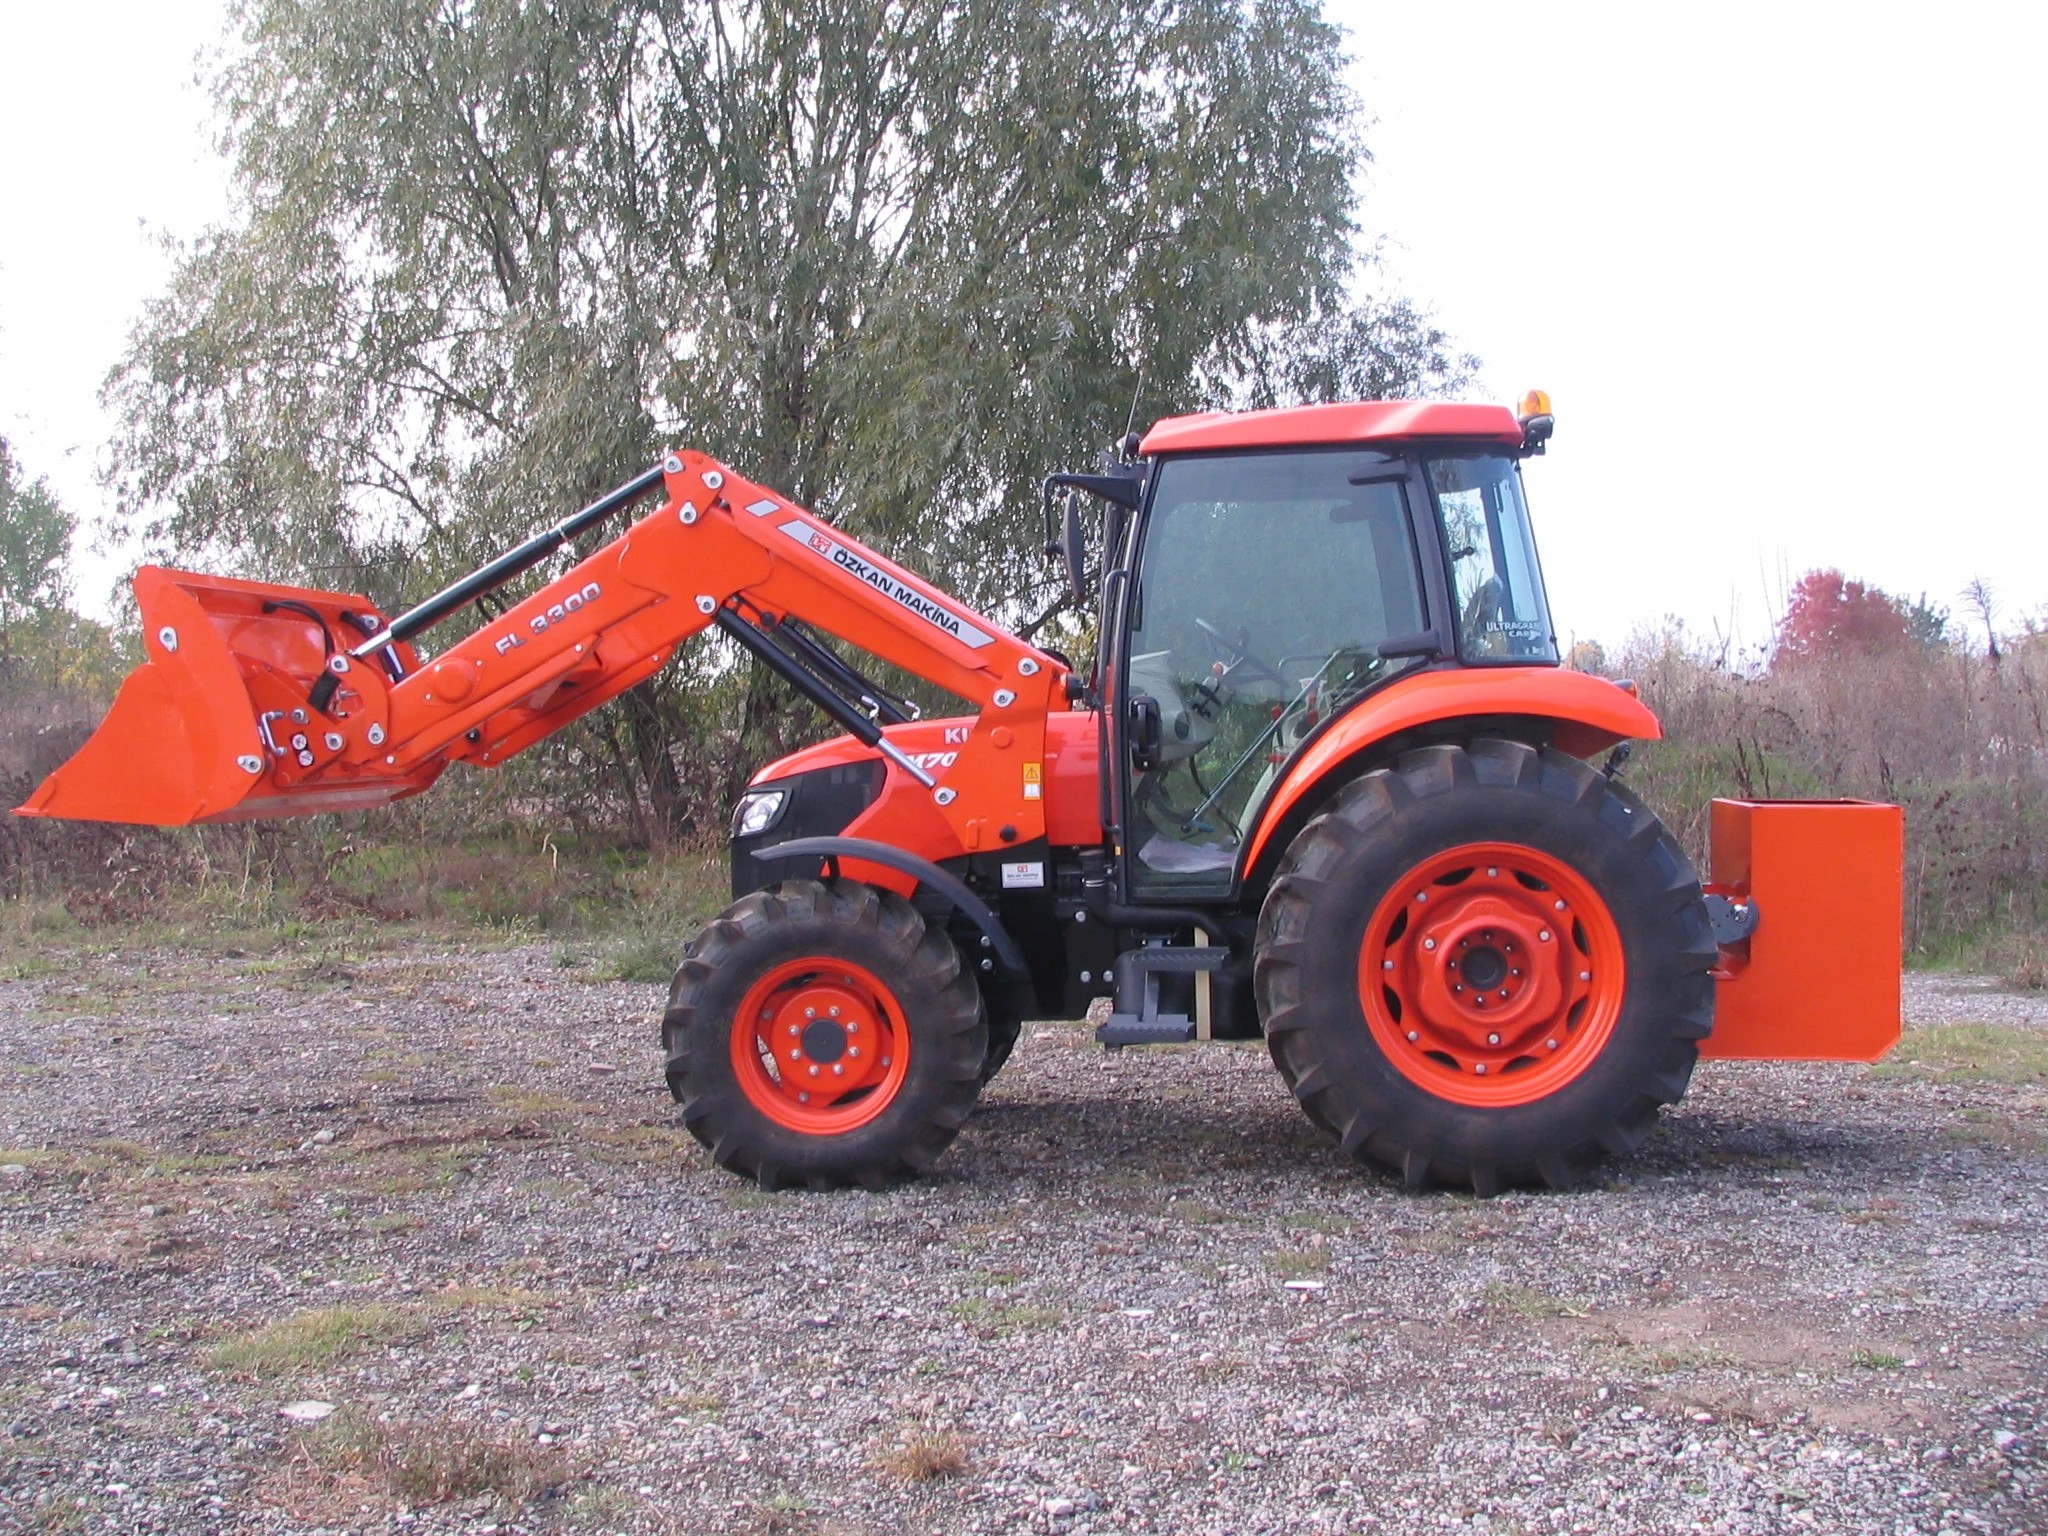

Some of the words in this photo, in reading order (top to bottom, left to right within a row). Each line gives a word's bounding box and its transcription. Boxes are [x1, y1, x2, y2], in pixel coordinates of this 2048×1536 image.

[494, 632, 527, 657] FL
[529, 582, 602, 635] 3300
[833, 549, 893, 593] ÖZKAN
[894, 587, 960, 635] MAKİNA
